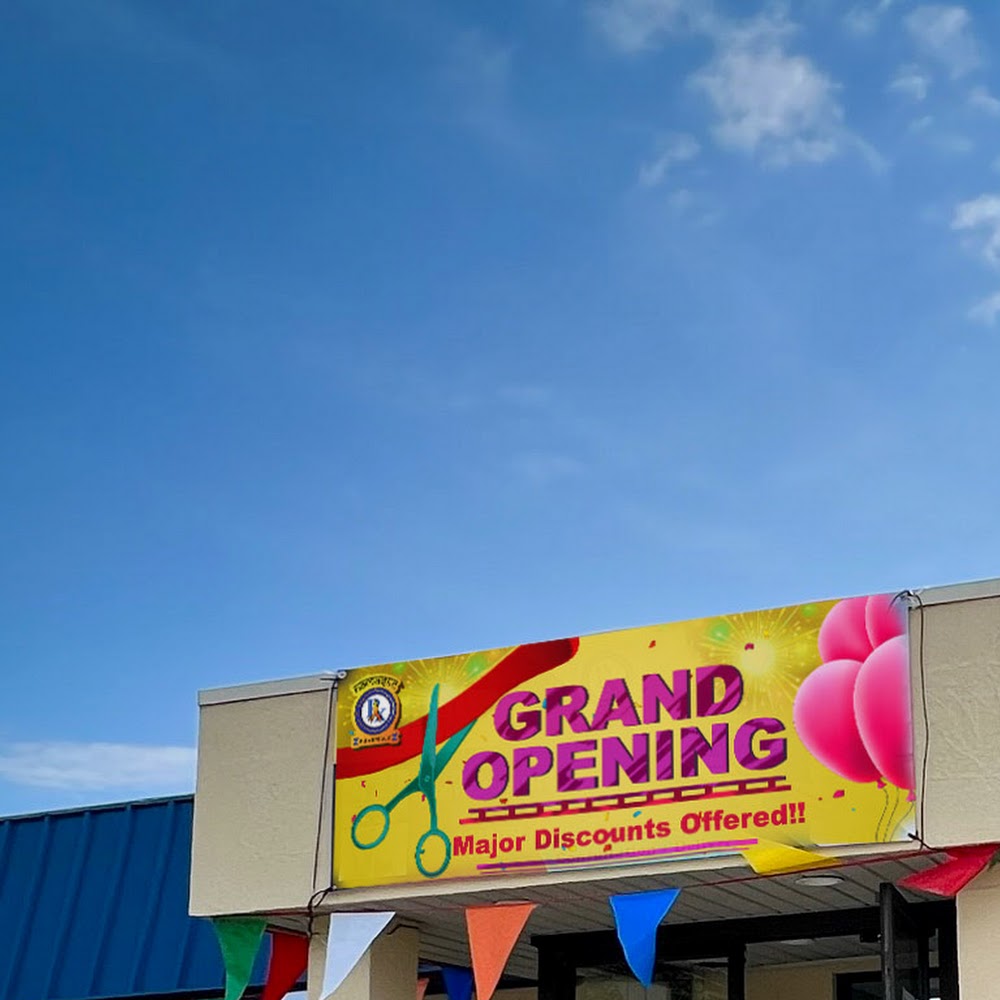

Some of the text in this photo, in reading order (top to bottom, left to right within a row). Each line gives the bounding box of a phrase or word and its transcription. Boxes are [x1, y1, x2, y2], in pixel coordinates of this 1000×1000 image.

[493, 664, 744, 742] GRAND
[461, 717, 788, 801] OPENING
[452, 801, 806, 859] Major Discounts Offered!!
